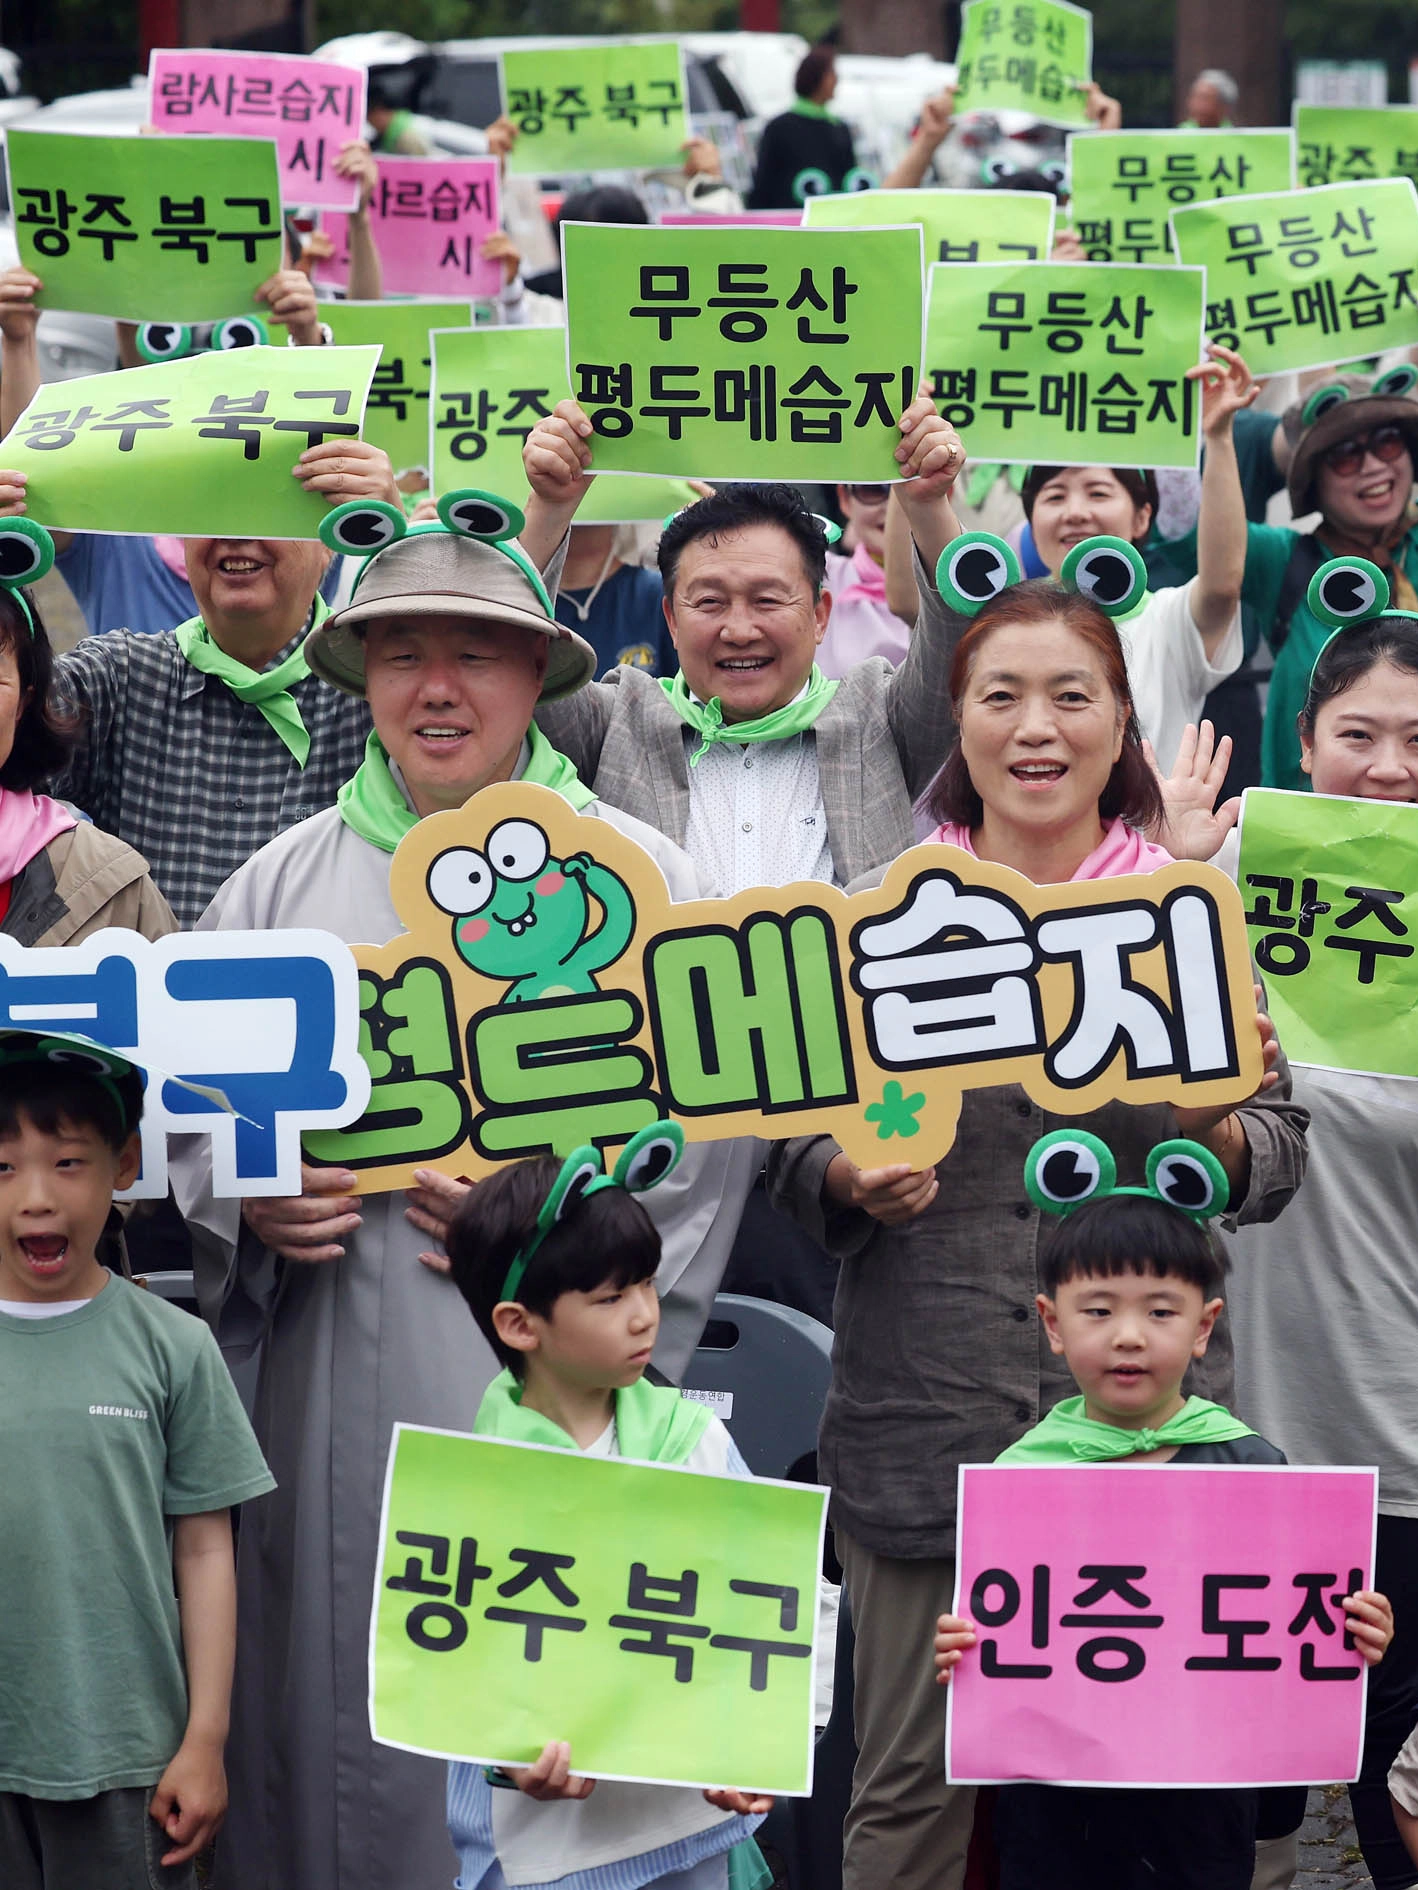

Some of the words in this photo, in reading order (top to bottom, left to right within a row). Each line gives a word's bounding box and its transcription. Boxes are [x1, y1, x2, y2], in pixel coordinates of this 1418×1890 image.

[161, 72, 353, 126] 람사르습지
[508, 86, 592, 136] 광주
[603, 81, 684, 129] 북구
[288, 137, 325, 183] 시
[1112, 154, 1252, 203] 무등산
[1299, 143, 1379, 188] 광주
[17, 187, 138, 262] 광주
[151, 195, 282, 265] 북구
[440, 235, 476, 276] 시
[1226, 207, 1378, 277] 무등산
[629, 264, 859, 345] 무등산
[978, 290, 1154, 355] 무등산
[14, 399, 174, 453] 광주
[191, 388, 361, 461] 북구
[575, 363, 914, 444] 평두메습지
[929, 368, 1194, 437] 평두메습지
[1245, 873, 1415, 984] 광주
[88, 1404, 122, 1417] GREEN
[123, 1408, 149, 1420] BLISS
[386, 1530, 587, 1662] 광주
[608, 1562, 812, 1692] 북구
[968, 1563, 1165, 1683] 인증
[1184, 1567, 1365, 1682] 도전
